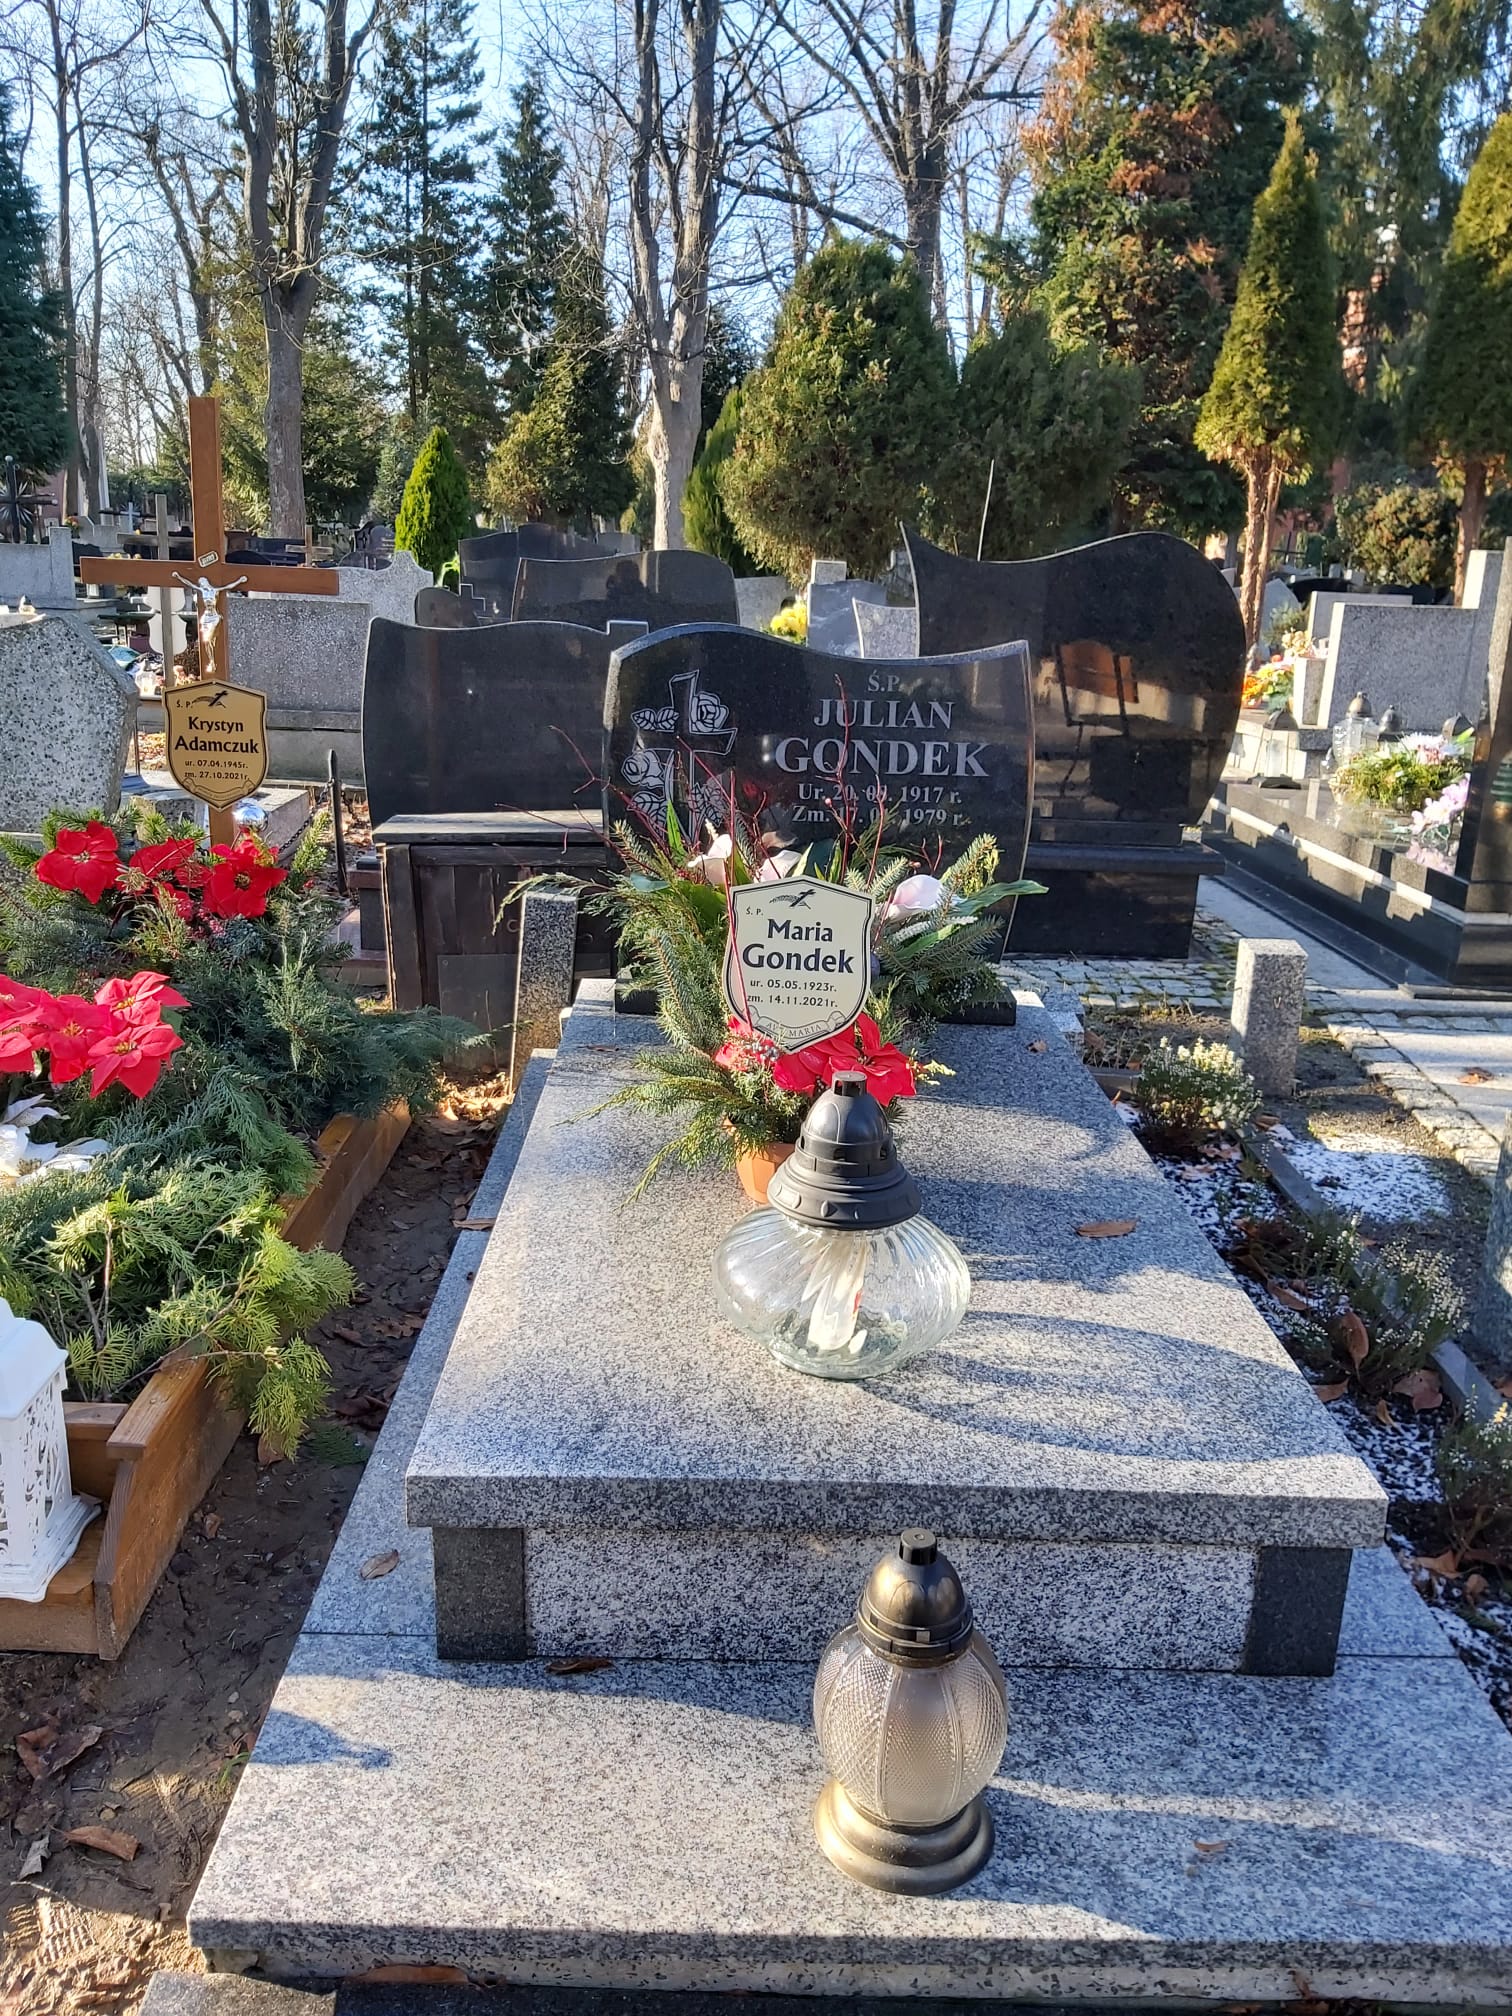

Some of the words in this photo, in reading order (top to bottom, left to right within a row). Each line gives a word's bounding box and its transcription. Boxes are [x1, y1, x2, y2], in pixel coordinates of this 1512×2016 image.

[813, 698, 955, 729] JULIAN
[188, 716, 244, 734] Krystyn
[174, 735, 260, 754] Adamczuk
[775, 737, 990, 777] GONDEK
[902, 786, 944, 804] 1917
[791, 805, 830, 823] Zm.
[904, 808, 948, 825] 1979
[767, 918, 833, 942] Maria
[742, 943, 855, 974] Gondek
[788, 1023, 822, 1038] MARIA
